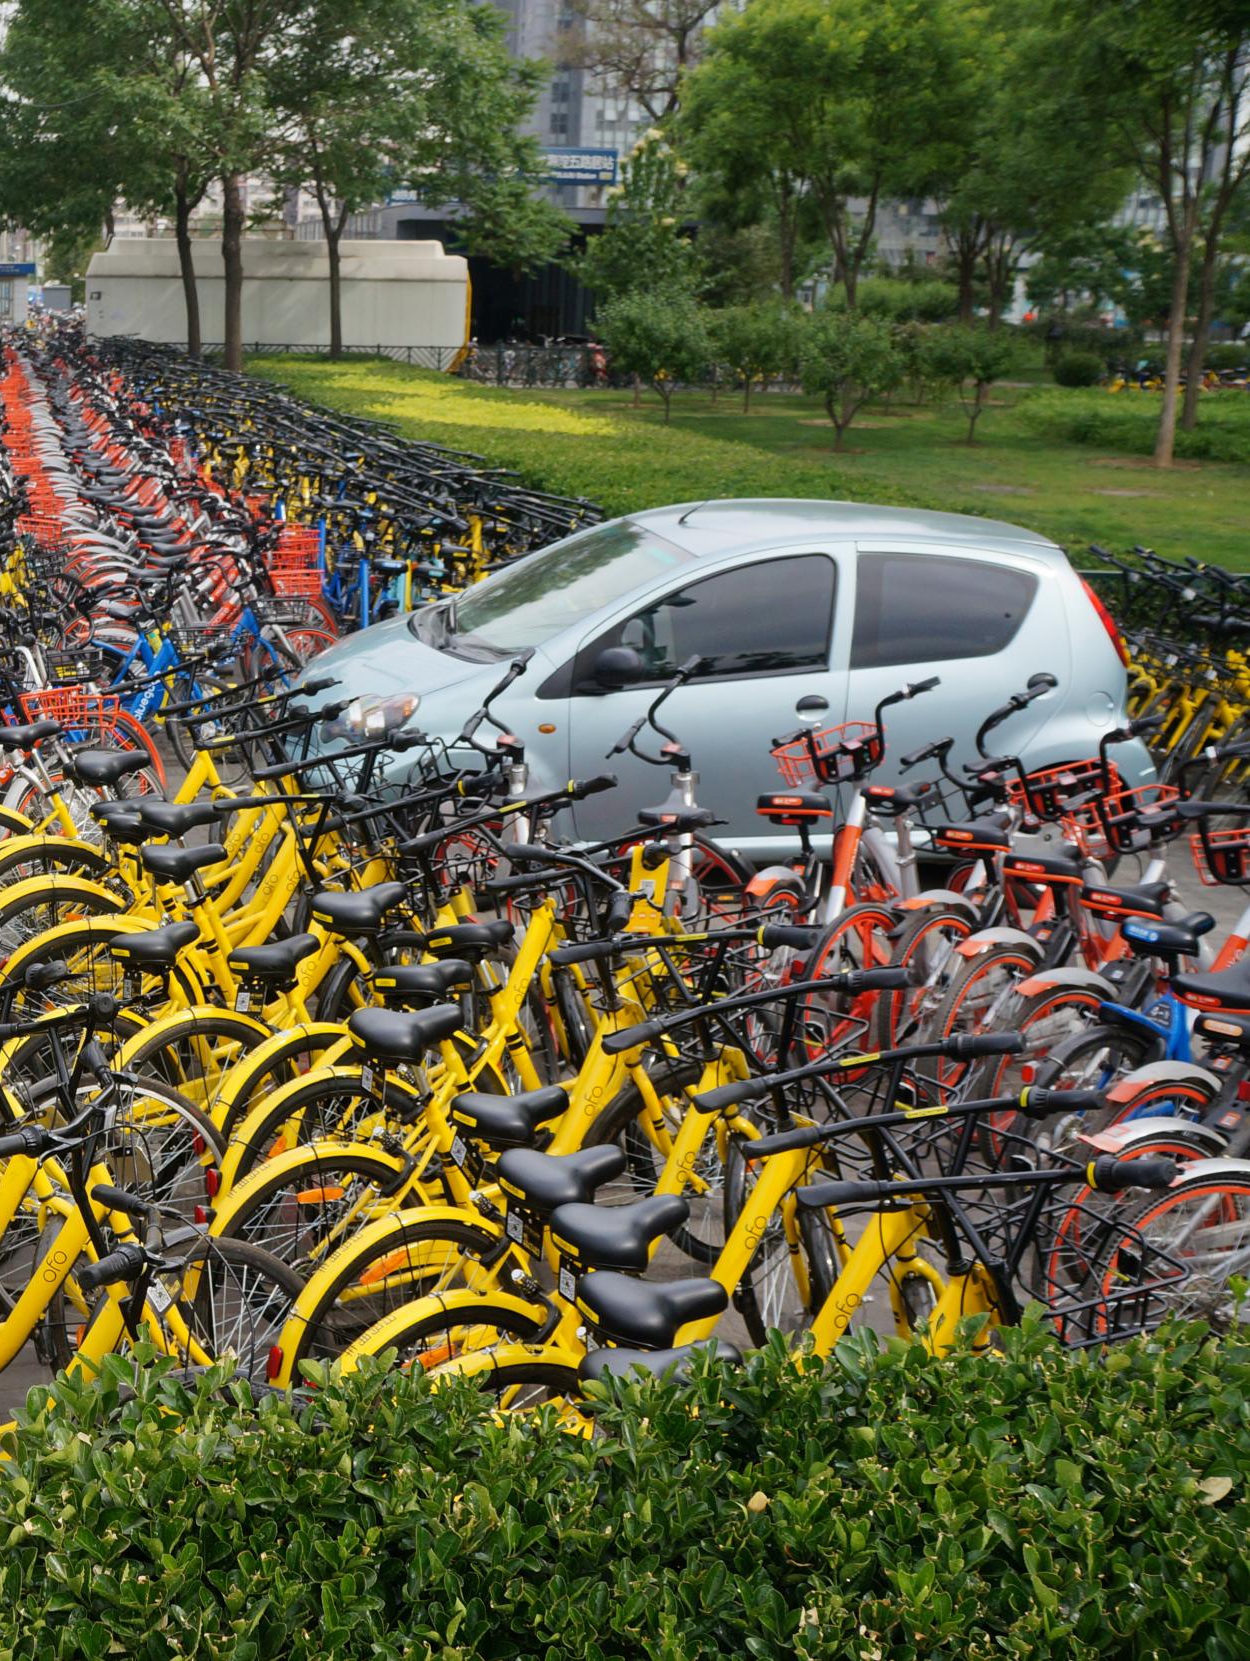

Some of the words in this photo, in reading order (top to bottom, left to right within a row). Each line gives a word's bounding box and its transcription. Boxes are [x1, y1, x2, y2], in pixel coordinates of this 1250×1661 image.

[255, 832, 270, 853] ofo
[263, 874, 278, 895] ofo
[286, 870, 300, 893] ofo
[302, 960, 317, 987] ofo
[514, 978, 529, 1005] ofo
[584, 1086, 603, 1116] ofo
[676, 1151, 695, 1184] ofo
[744, 1215, 767, 1250] ofo
[43, 1250, 67, 1283] ofo
[834, 1292, 860, 1329] ofo
